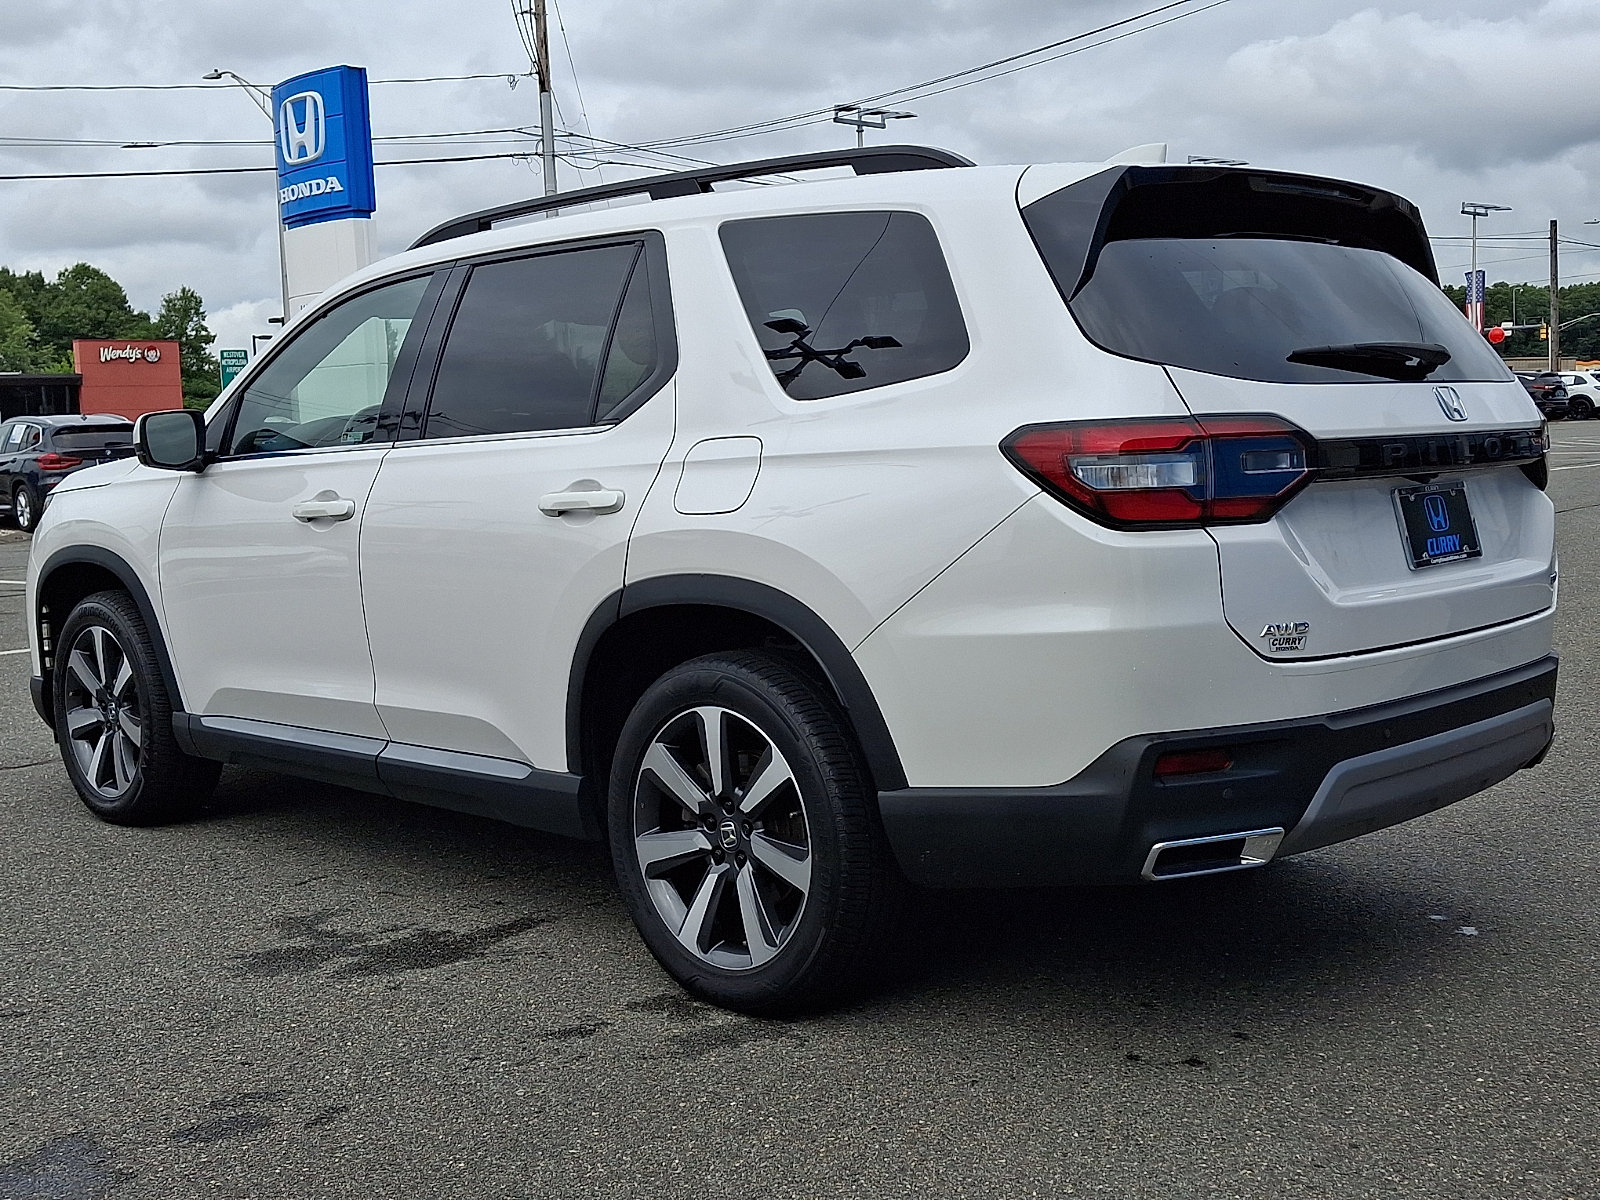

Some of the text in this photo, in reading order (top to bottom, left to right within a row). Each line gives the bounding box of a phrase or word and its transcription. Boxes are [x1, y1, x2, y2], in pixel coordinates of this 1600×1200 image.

[279, 177, 343, 205] HONDA
[100, 344, 142, 363] Wendy's
[1382, 433, 1531, 466] PILOT
[1427, 534, 1461, 556] CURRY
[1260, 621, 1310, 637] AWD
[1271, 637, 1304, 647] CURRY
